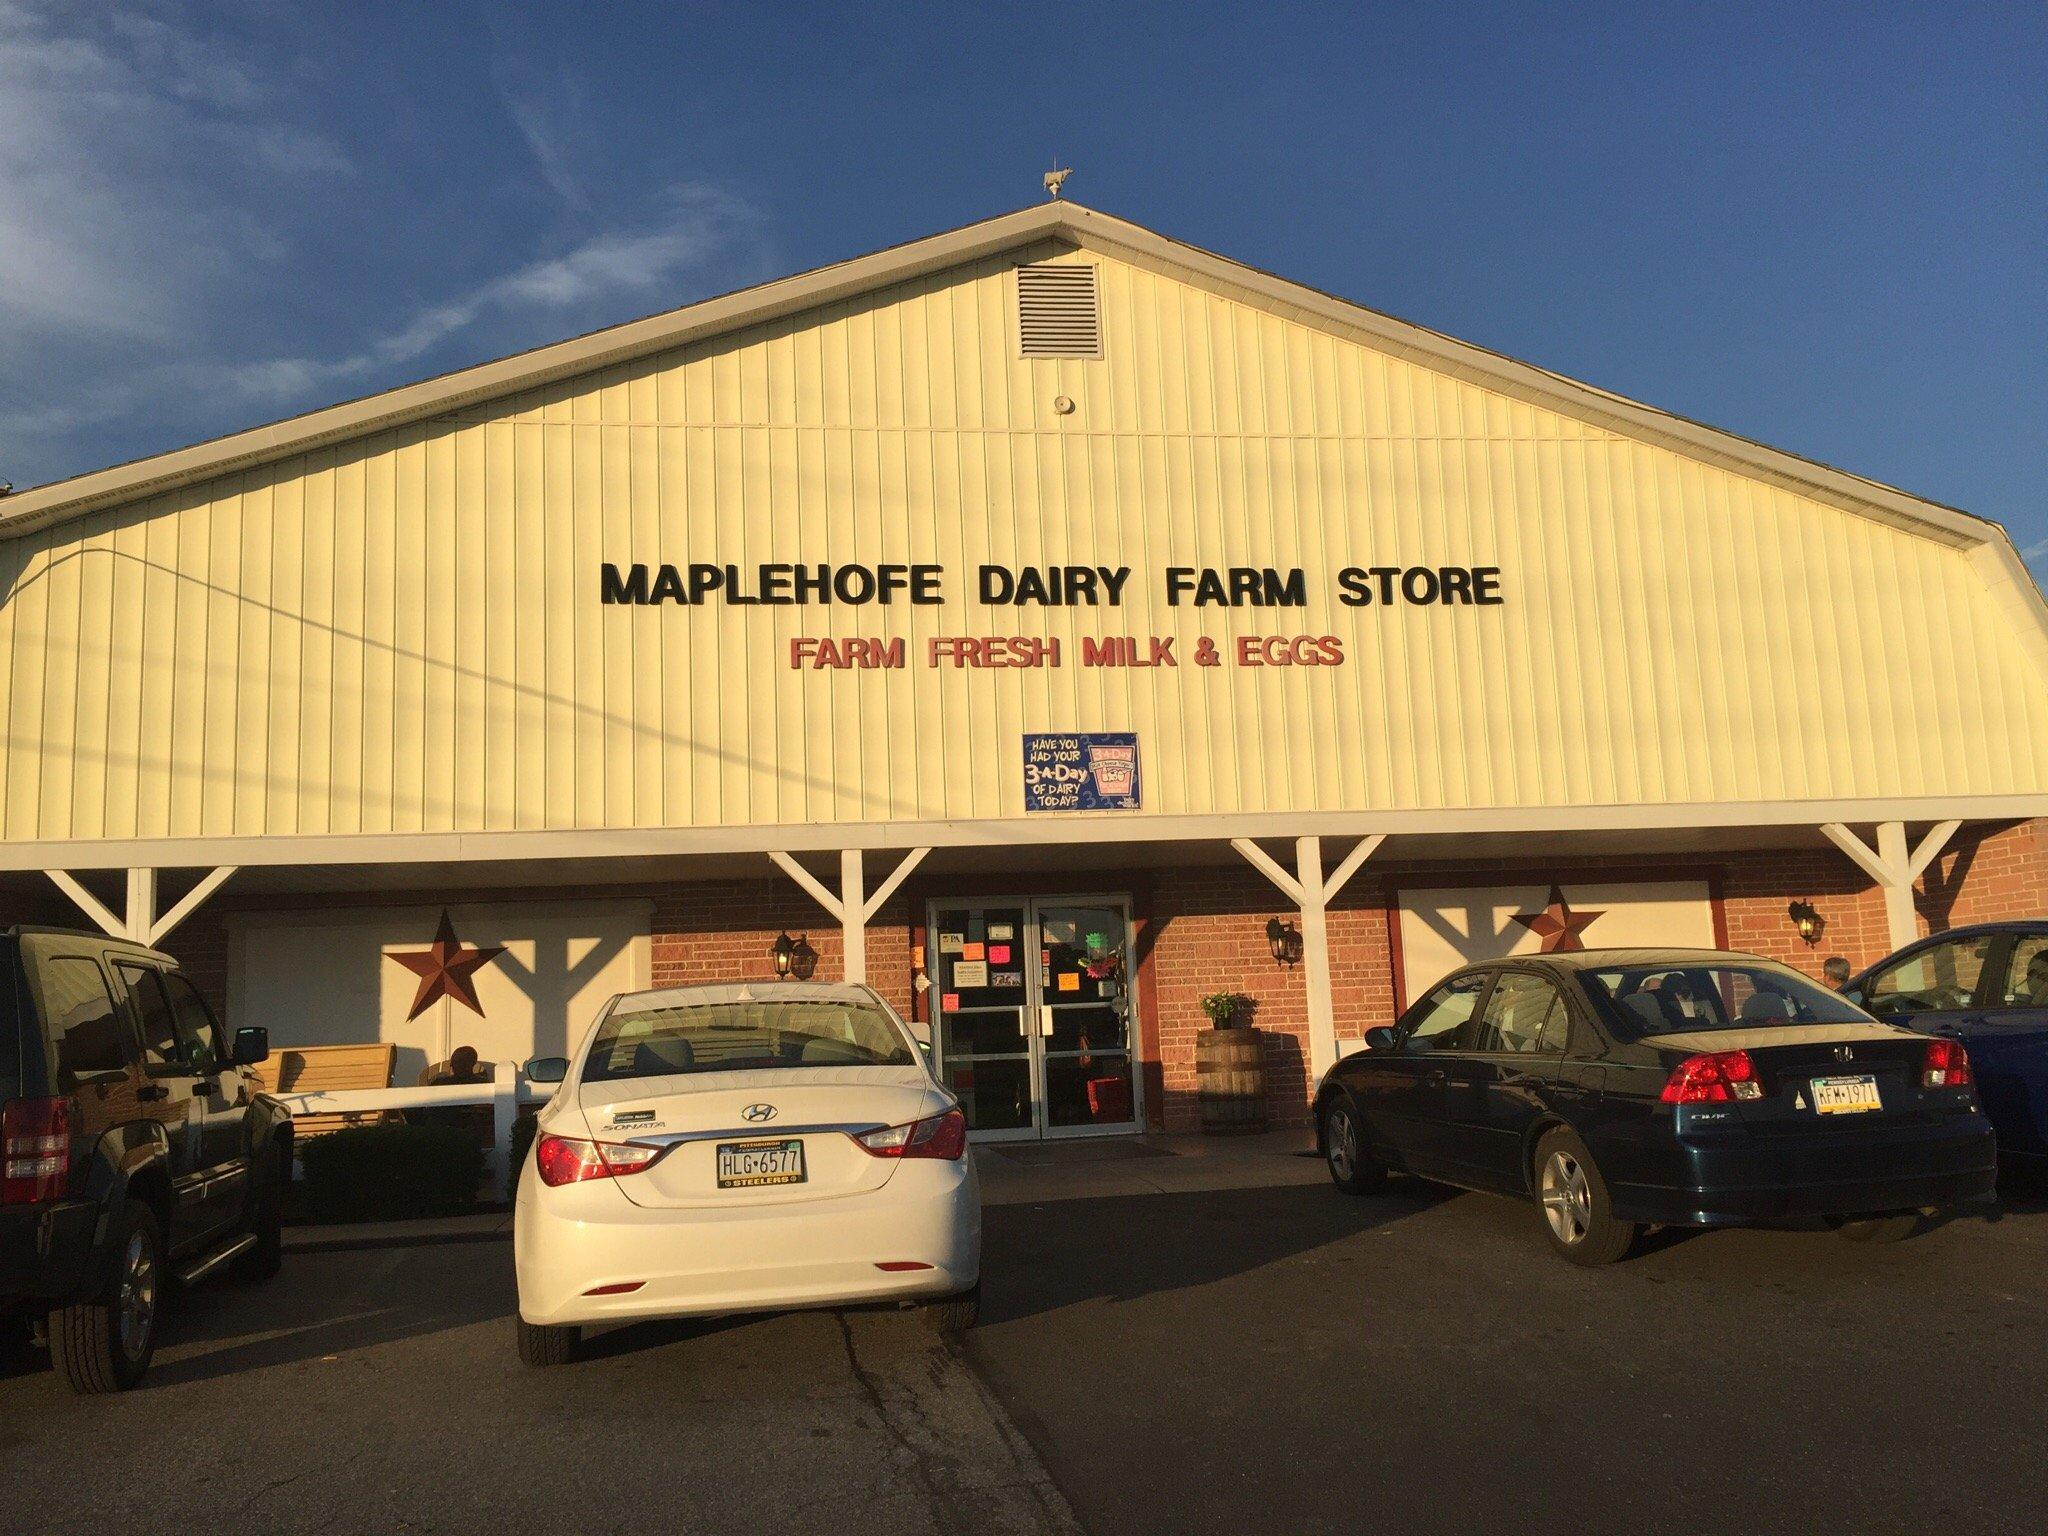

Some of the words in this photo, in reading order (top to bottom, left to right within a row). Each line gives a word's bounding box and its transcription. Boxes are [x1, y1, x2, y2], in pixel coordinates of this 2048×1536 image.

[601, 563, 945, 605] MAPLEHOFE
[979, 565, 1131, 606] DAIRY
[1166, 567, 1307, 606] FARM
[1338, 566, 1504, 606] STORE
[791, 637, 905, 669] FARM
[928, 637, 1061, 668] FRESH
[1083, 637, 1178, 667] MILK
[1194, 636, 1221, 667] &
[1237, 636, 1344, 667] EGGS
[1032, 739, 1057, 751] HAVE
[1060, 739, 1078, 750] YOU
[1030, 752, 1051, 762] HAD
[1054, 751, 1081, 762] YOUR
[1025, 764, 1088, 785] 3-A-Day
[1033, 784, 1046, 795] OF
[1048, 783, 1080, 795] DAIRY
[1037, 795, 1079, 807] TODAY?
[733, 1176, 790, 1187] STEELERS
